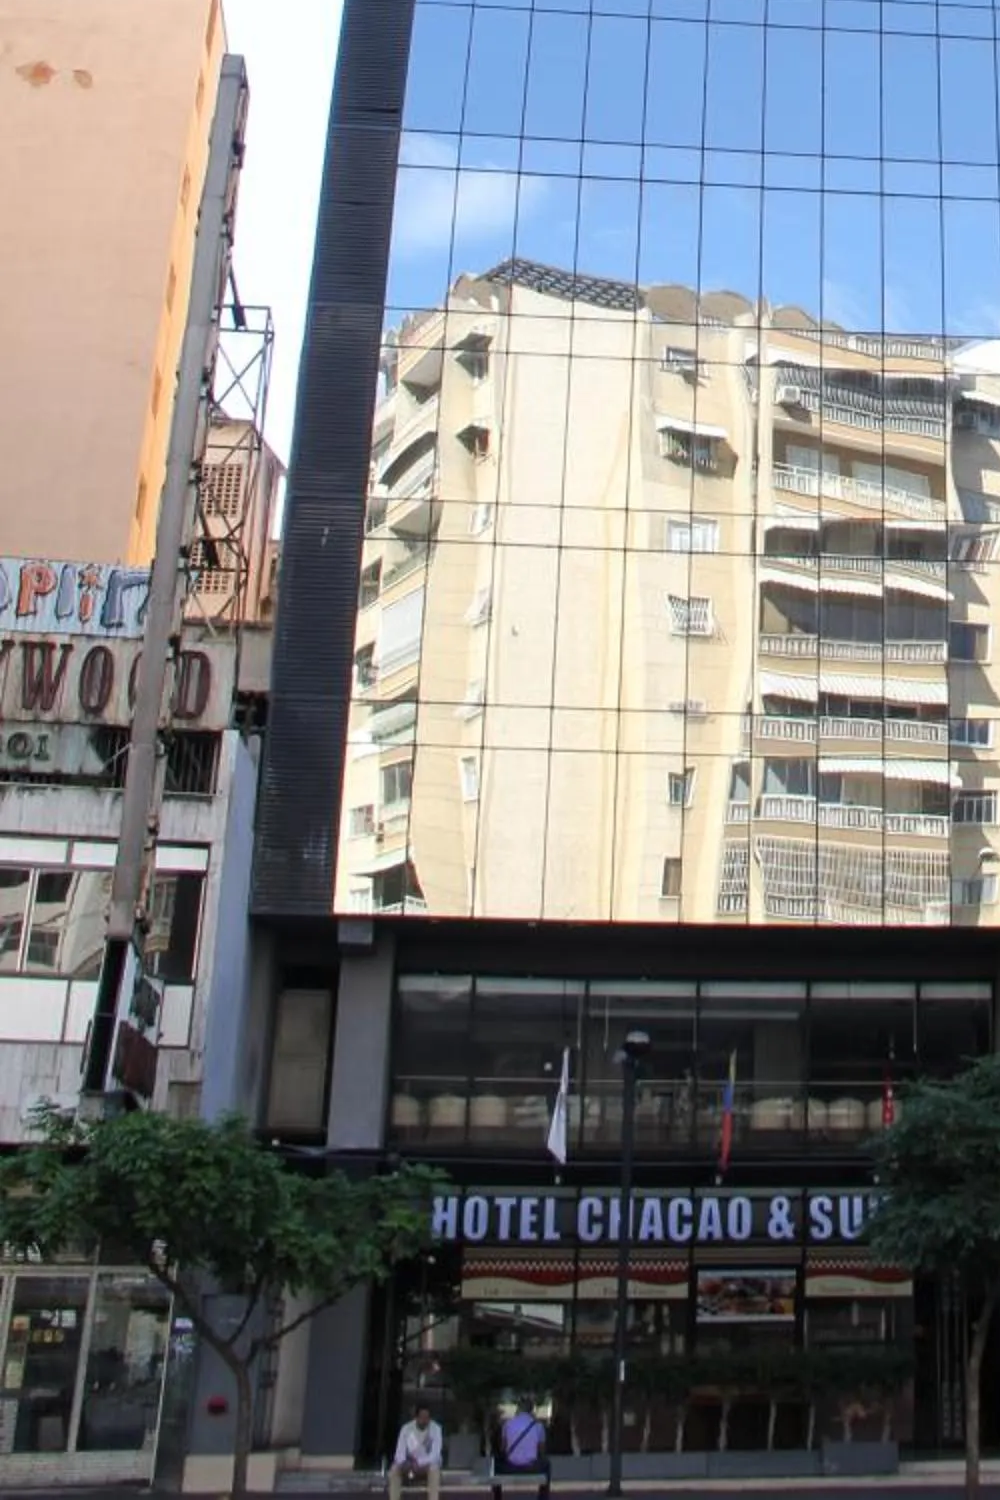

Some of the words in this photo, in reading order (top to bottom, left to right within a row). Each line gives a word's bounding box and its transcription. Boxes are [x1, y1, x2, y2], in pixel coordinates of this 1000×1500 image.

[432, 1196, 560, 1240] HOTEL
[577, 1196, 752, 1241] CHACAO
[767, 1195, 794, 1239] &
